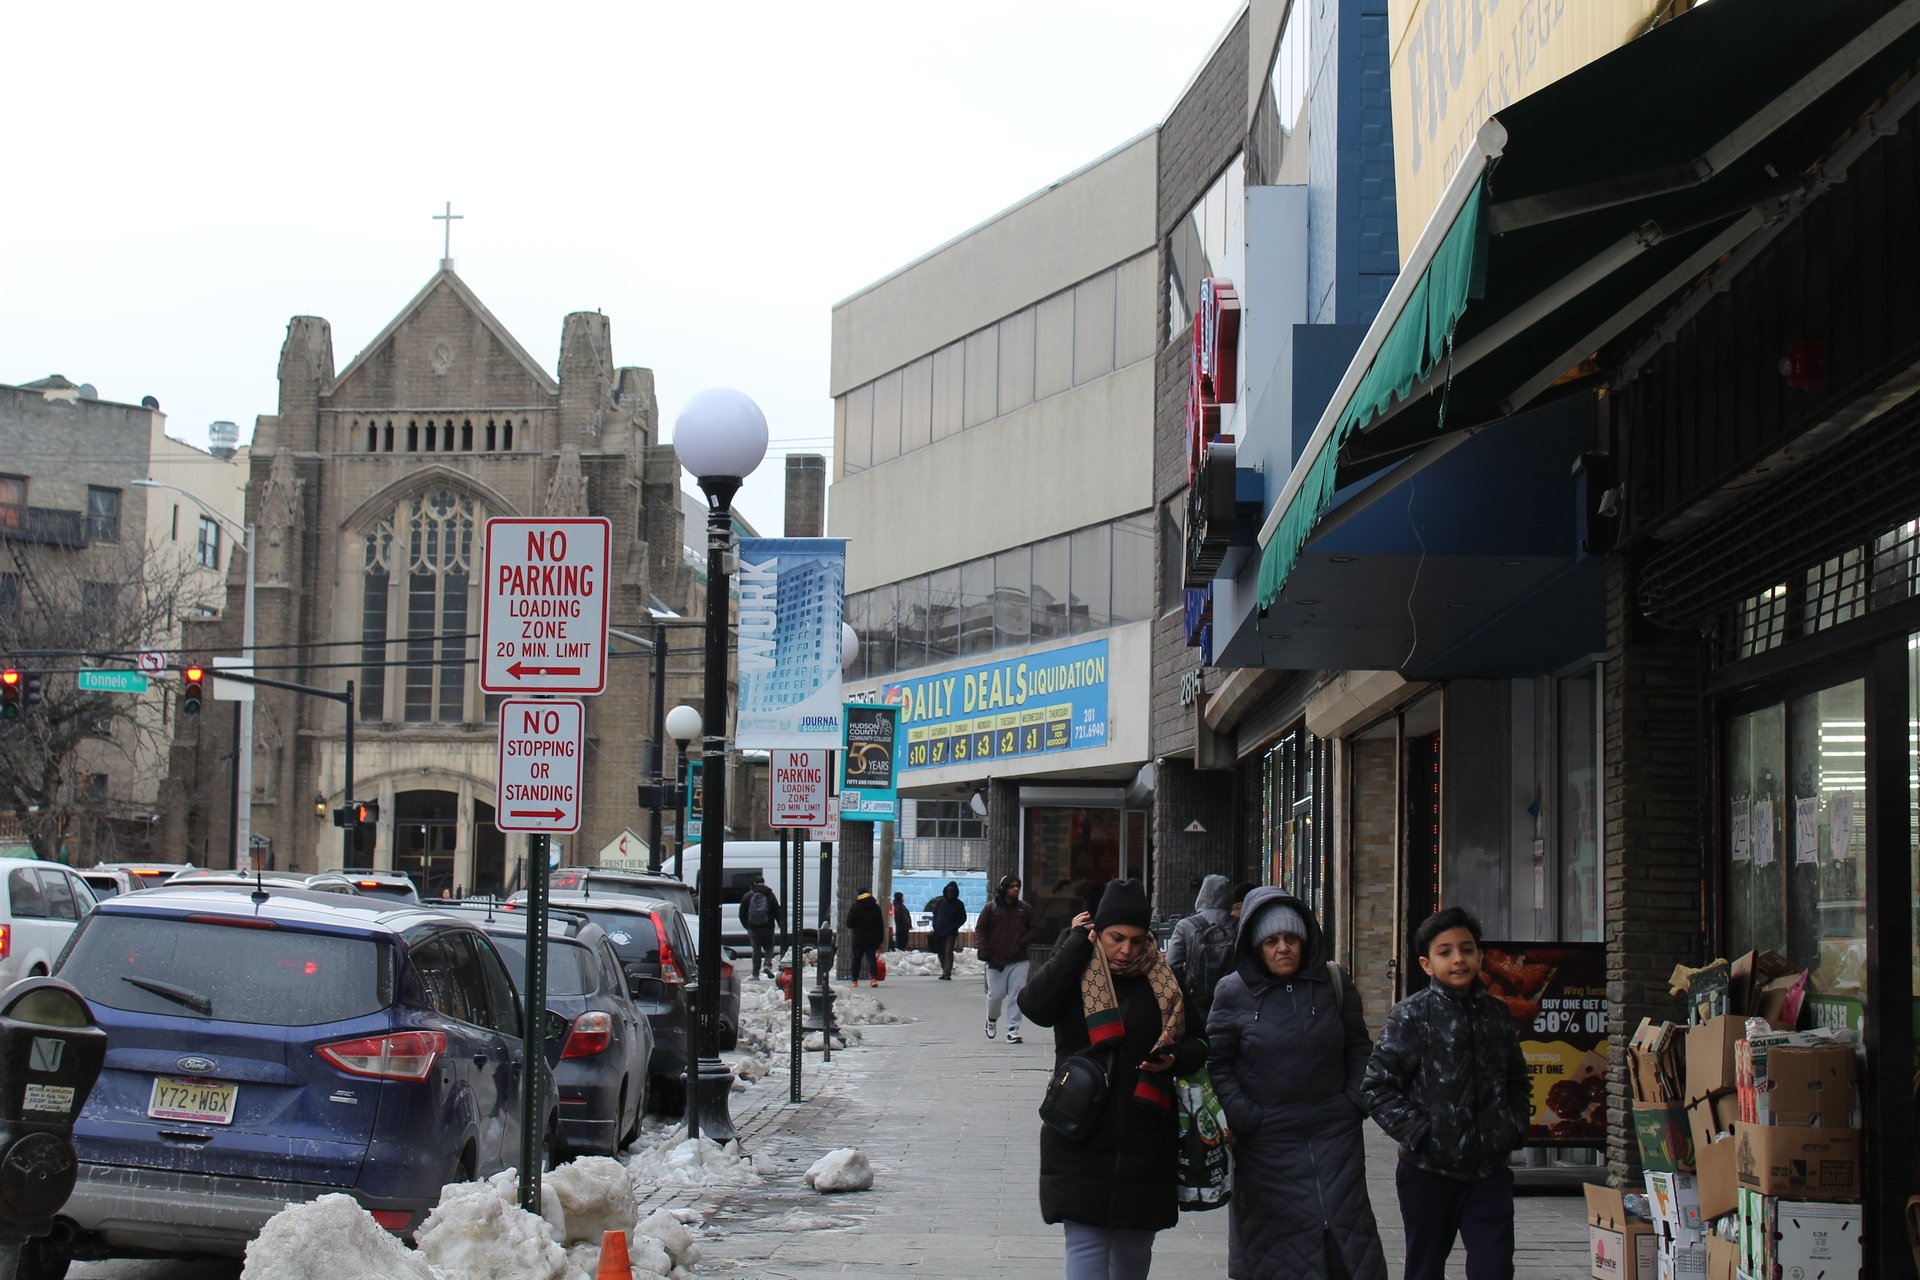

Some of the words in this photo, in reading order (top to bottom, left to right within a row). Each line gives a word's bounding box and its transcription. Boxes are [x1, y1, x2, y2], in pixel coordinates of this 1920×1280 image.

[527, 530, 567, 562] NO
[499, 565, 593, 597] PARKING
[510, 600, 580, 618] LOADING
[738, 556, 778, 671] WORK
[522, 621, 567, 639] ZONE
[497, 642, 515, 658] 20
[522, 642, 550, 658] MIN.
[556, 642, 591, 659] LIMIT
[84, 671, 128, 689] Tonnele
[1181, 668, 1201, 706] 2815
[900, 676, 957, 724] DAILY
[964, 662, 1028, 714] DEALS
[1028, 656, 1105, 697] LIQUIDATION
[523, 710, 560, 735] NO
[802, 716, 838, 726] JOURNAL
[1084, 708, 1095, 723] 201
[1026, 728, 1038, 751] $1
[1075, 722, 1105, 740] 721.6940
[507, 740, 574, 757] STOPPING
[955, 738, 967, 760] $5
[977, 735, 990, 757] $3
[1001, 731, 1014, 755] $2
[789, 752, 809, 768] NO
[848, 742, 890, 775] 50
[910, 745, 926, 765] $10
[932, 742, 944, 763] $7
[530, 763, 550, 779] OR
[868, 760, 889, 771] YEARS
[777, 768, 821, 784] PARKING
[505, 785, 573, 802] STANDING
[782, 784, 816, 793] LOADING
[776, 803, 786, 811] 20
[804, 803, 821, 811] LIMIT
[788, 794, 810, 802] ZONE
[600, 859, 624, 868] CHRIST
[1563, 986, 1584, 997] Wing
[1542, 999, 1561, 1009] BUY
[1562, 999, 1581, 1009] ONE
[1582, 999, 1600, 1009] GET
[1533, 1011, 1580, 1033] 50%
[1585, 1011, 1609, 1033] OF
[184, 1056, 206, 1071] Ford
[1528, 1064, 1544, 1075] GET
[1546, 1064, 1564, 1075] ONE
[159, 1085, 189, 1109] Y72
[199, 1092, 231, 1112] WGX
